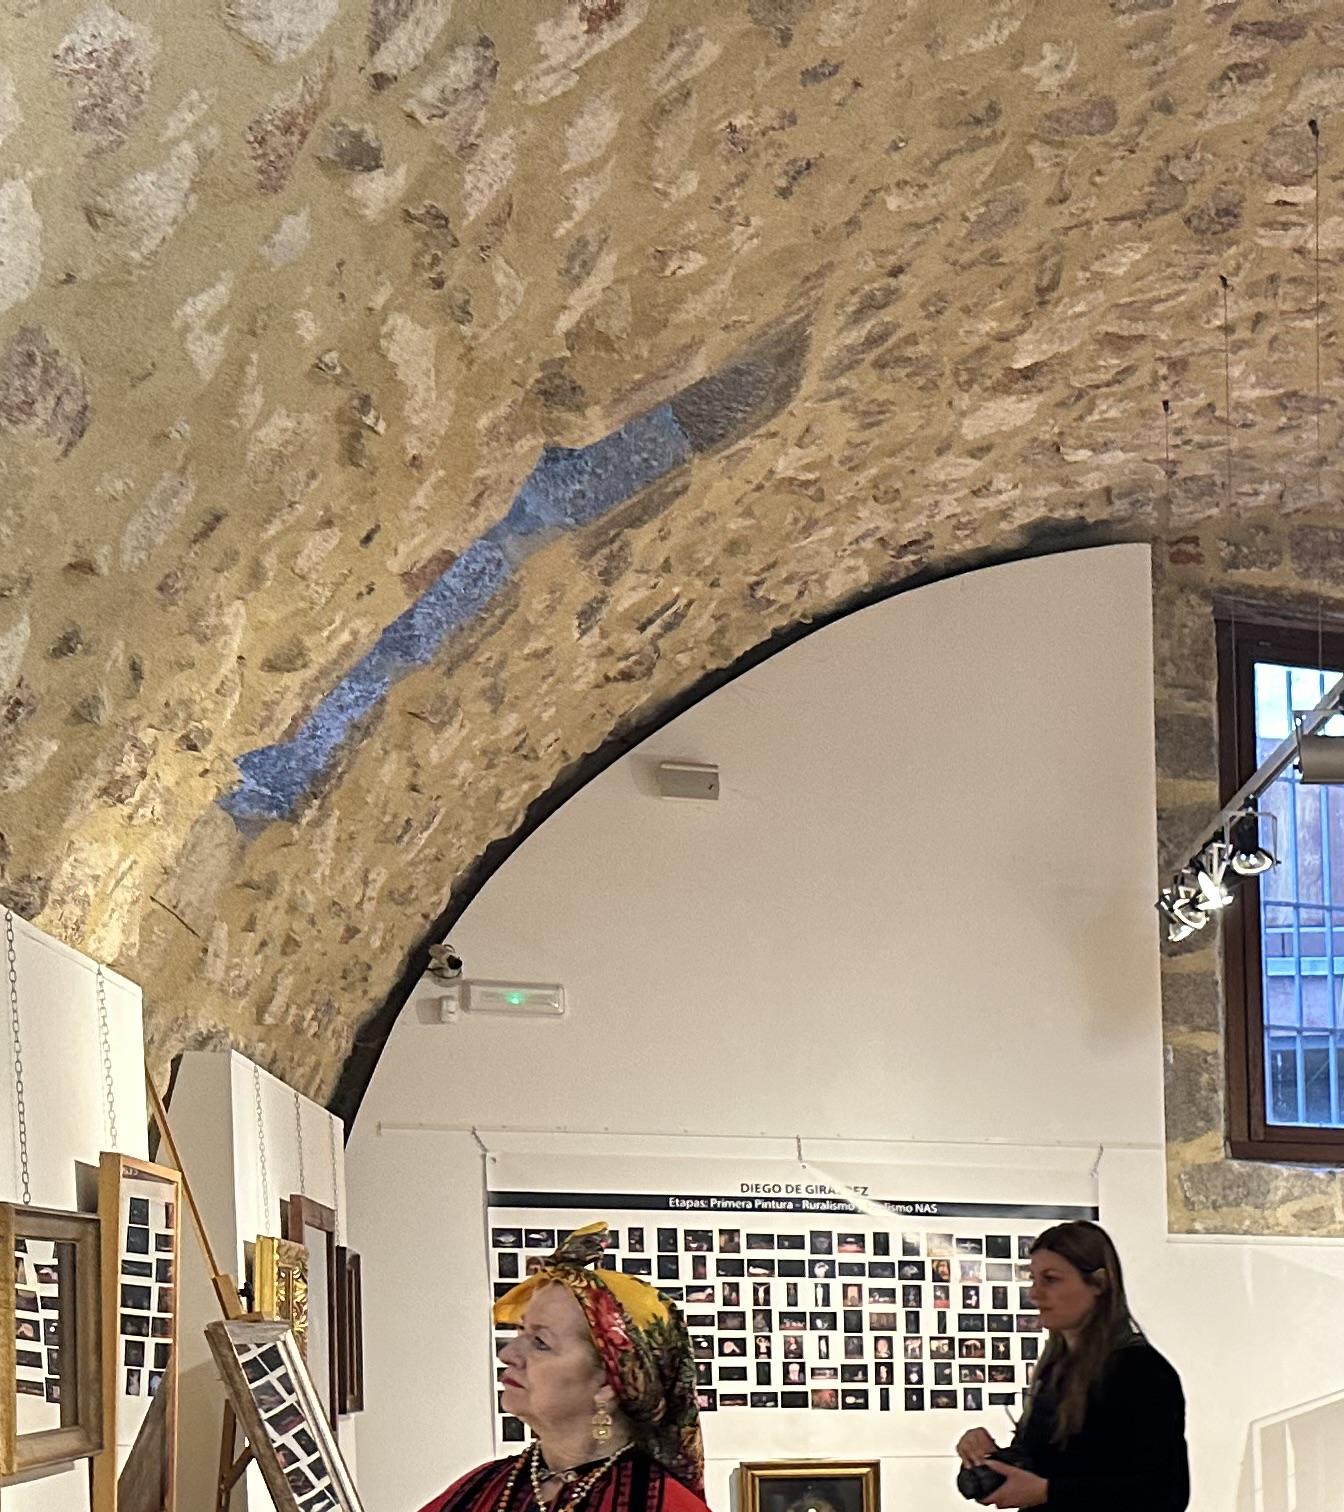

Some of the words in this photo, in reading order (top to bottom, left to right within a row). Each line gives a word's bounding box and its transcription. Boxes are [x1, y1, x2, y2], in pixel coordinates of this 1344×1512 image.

[740, 1183, 782, 1194] DIEGO
[785, 1184, 801, 1194] DE
[710, 1198, 752, 1209] Primera
[754, 1199, 794, 1209] Pintura
[802, 1200, 856, 1211] Ruralismo
[915, 1203, 938, 1214] NAS
